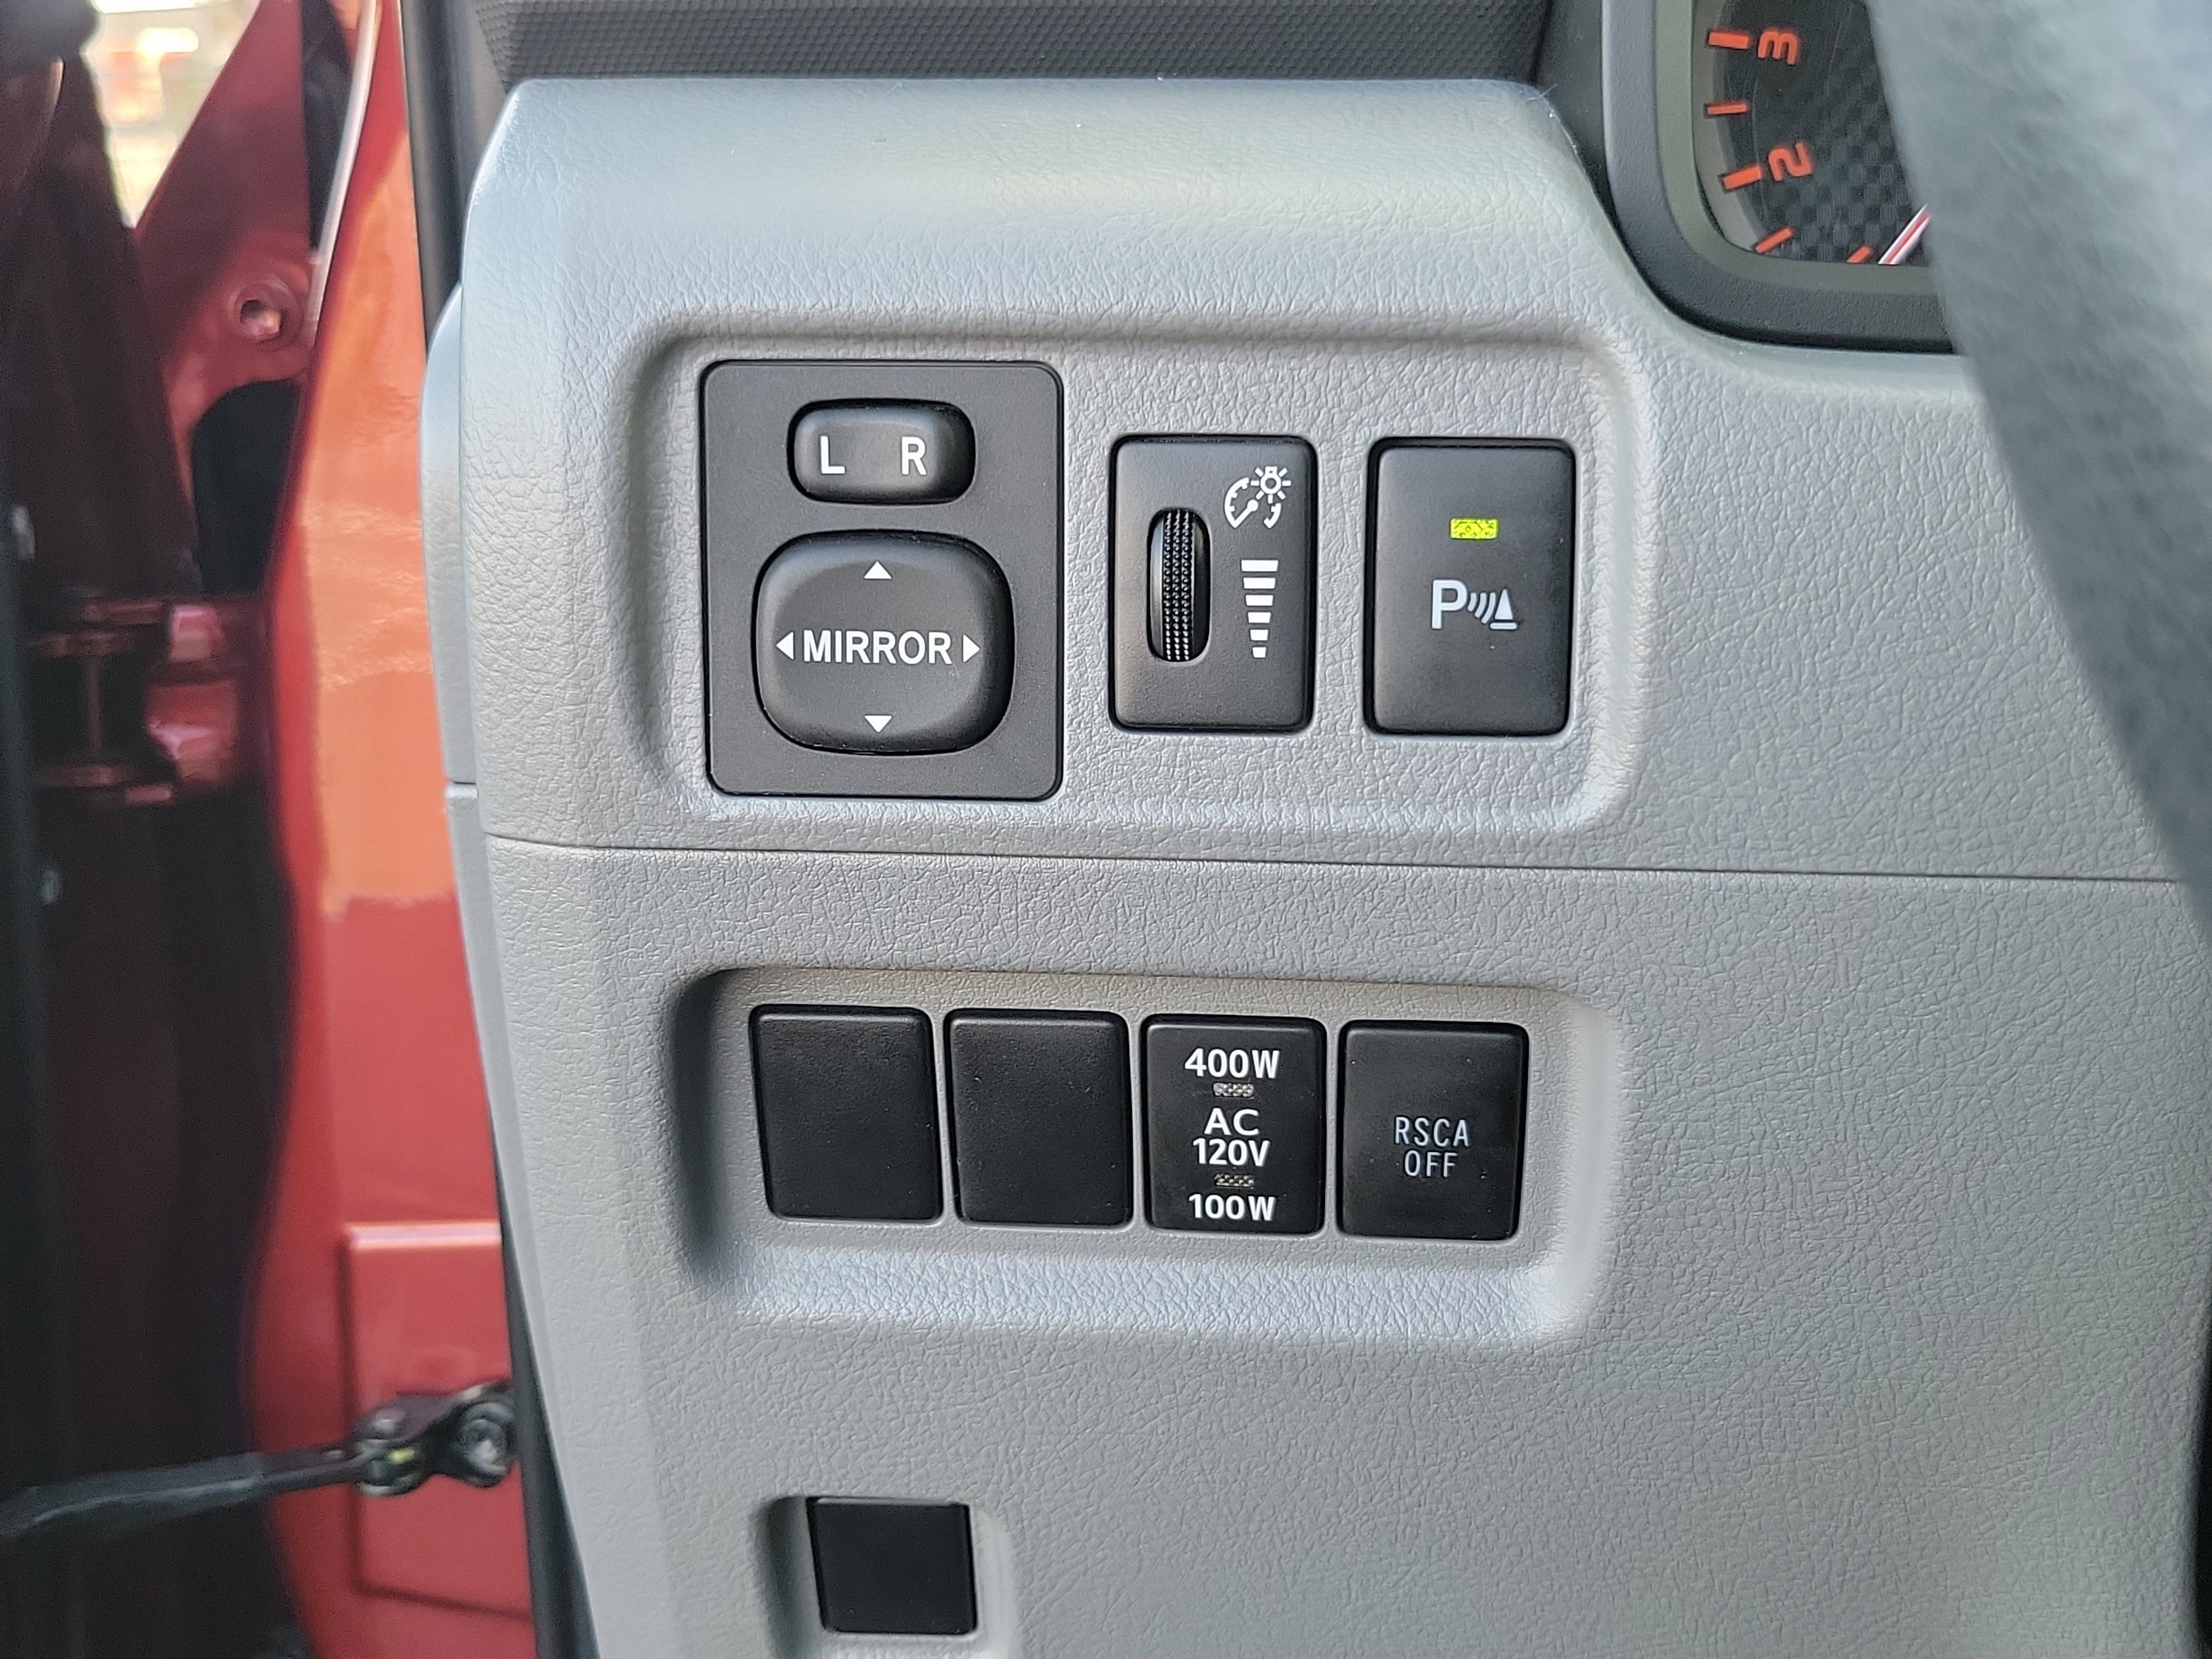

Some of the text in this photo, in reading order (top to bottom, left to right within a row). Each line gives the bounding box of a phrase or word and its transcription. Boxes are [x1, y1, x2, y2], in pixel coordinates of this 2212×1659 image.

[1758, 27, 1799, 65] 3
[1768, 141, 1813, 182] 2
[820, 436, 927, 475] L R
[803, 629, 952, 664] MIRROR
[1184, 1048, 1279, 1079] 400W
[1204, 1108, 1260, 1136] AC
[1395, 1116, 1470, 1148] RSCA
[1192, 1138, 1271, 1167] 120V
[1404, 1150, 1458, 1178] OFF
[1189, 1194, 1276, 1222] 100W
